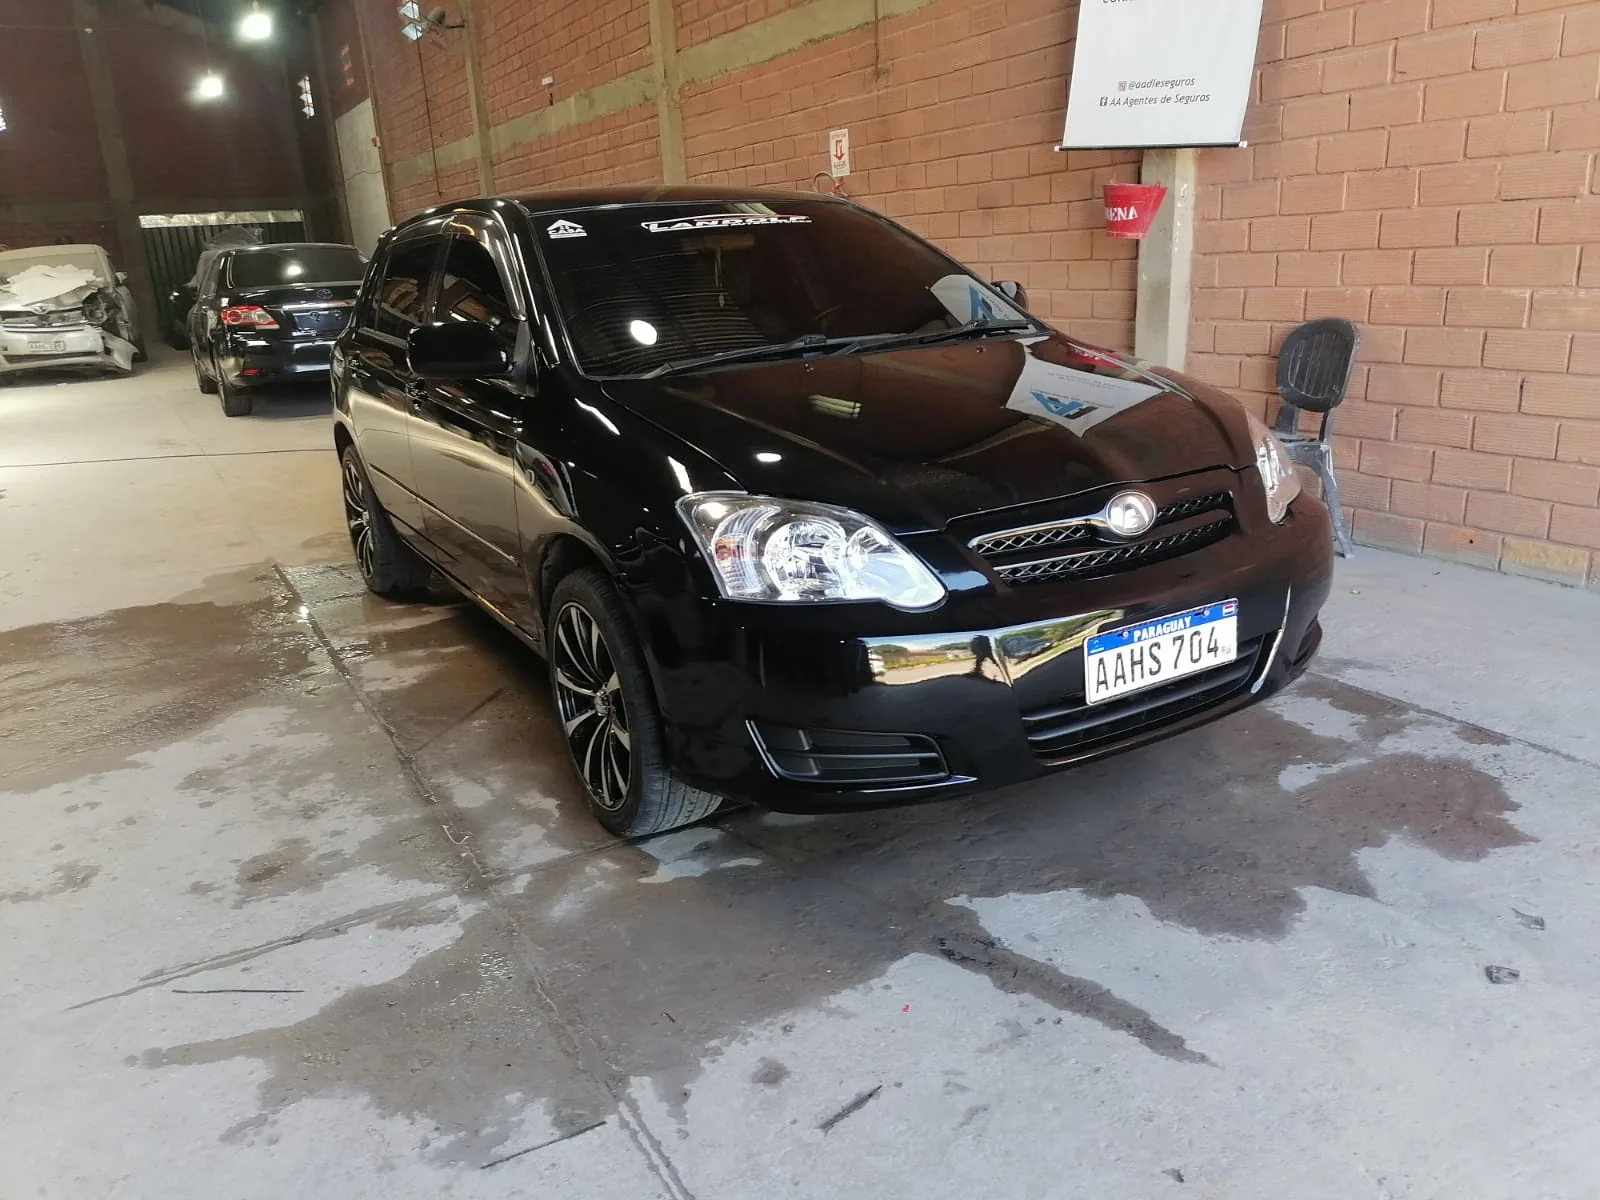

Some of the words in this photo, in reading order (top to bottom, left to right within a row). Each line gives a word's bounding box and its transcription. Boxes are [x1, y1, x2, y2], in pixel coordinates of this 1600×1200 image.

[1109, 97, 1121, 106] AA
[1122, 95, 1158, 107] Agentes
[1160, 94, 1172, 104] de
[1174, 93, 1211, 105] Seguros
[1133, 616, 1192, 642] PARAGUAY
[1096, 641, 1162, 694] AAHS
[1172, 626, 1219, 670] 704
